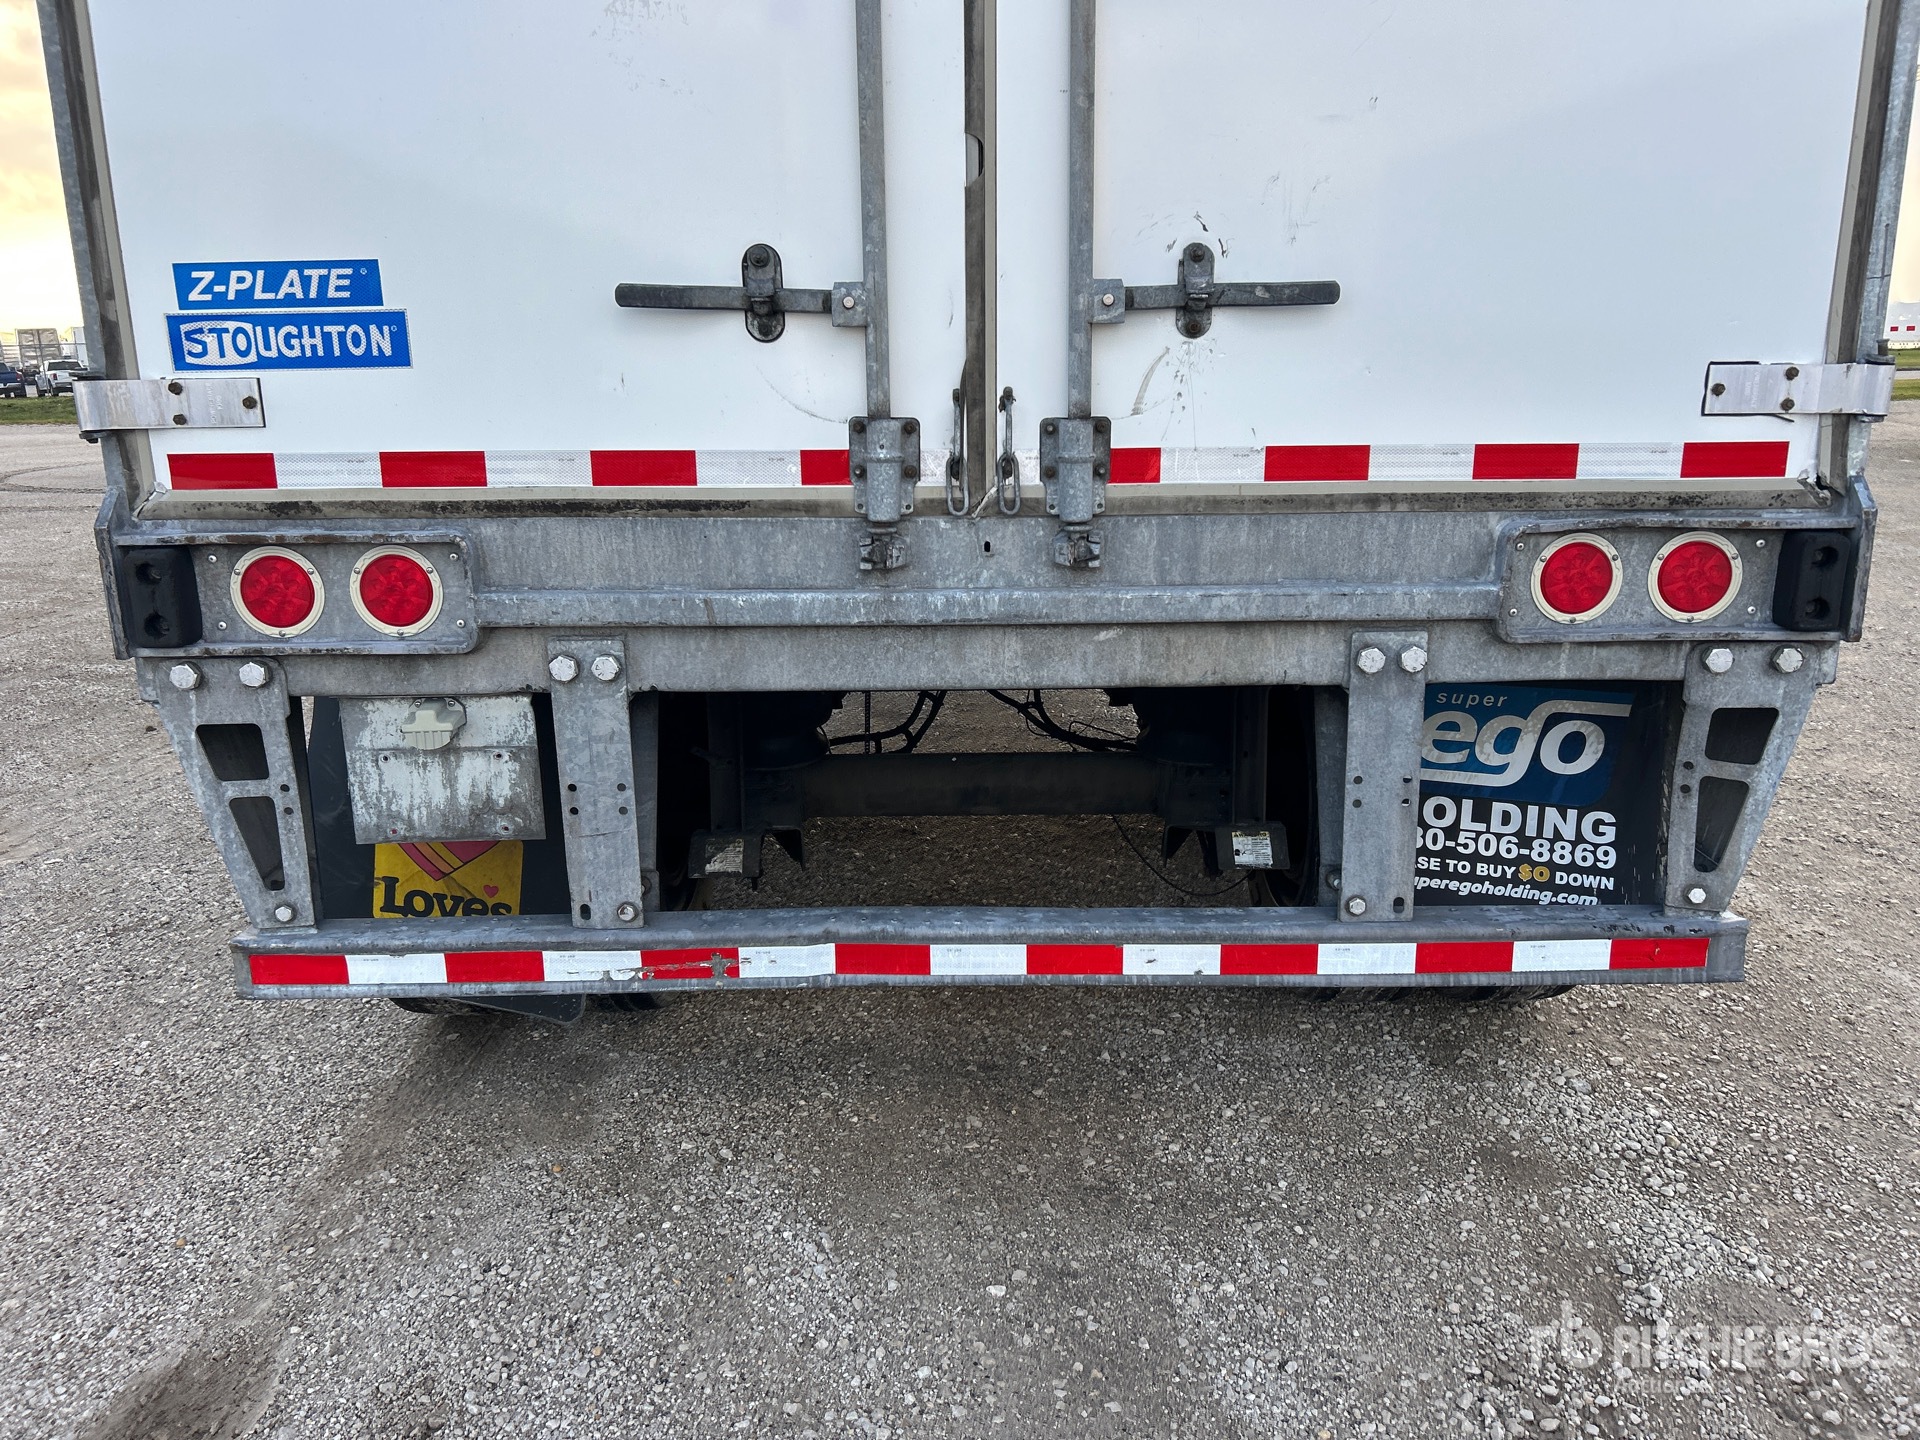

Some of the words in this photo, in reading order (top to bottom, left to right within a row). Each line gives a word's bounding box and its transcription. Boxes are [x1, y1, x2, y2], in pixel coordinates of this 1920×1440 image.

[188, 267, 354, 302] Z-PLATE
[183, 323, 393, 359] STOUGHTON
[1436, 692, 1508, 709] super
[1420, 700, 1632, 787] ego
[1423, 796, 1617, 844] OLDING
[1415, 856, 1441, 871] SE
[1445, 859, 1471, 874] TO
[1476, 862, 1517, 879] BUY
[1555, 871, 1615, 891] DOWN
